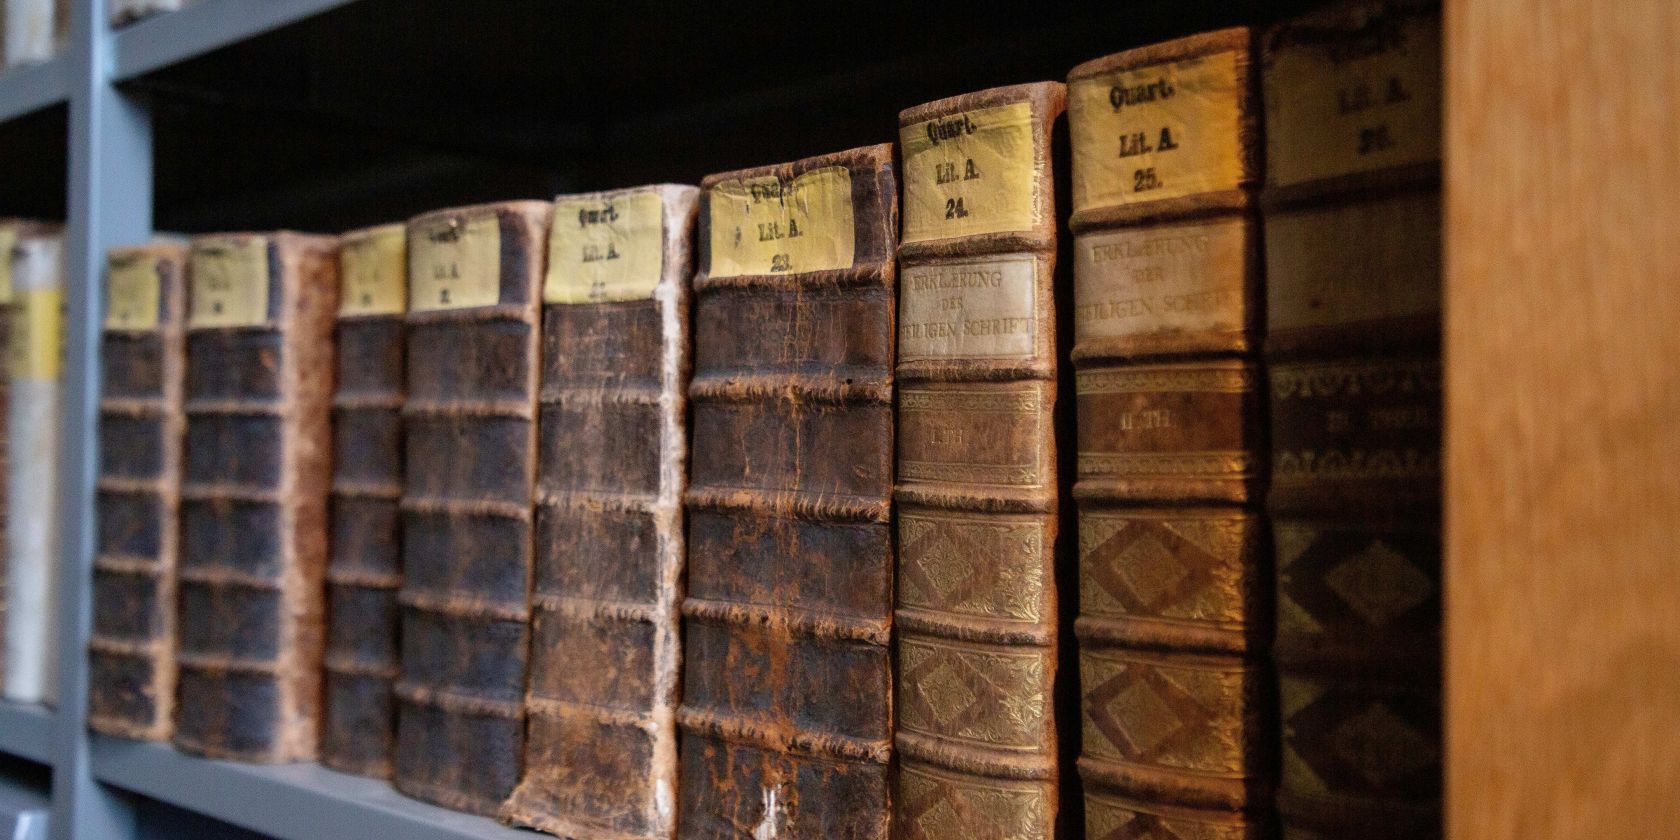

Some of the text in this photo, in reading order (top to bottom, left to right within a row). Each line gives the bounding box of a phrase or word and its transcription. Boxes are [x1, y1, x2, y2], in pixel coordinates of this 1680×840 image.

[1109, 78, 1176, 113] Quart.
[1119, 132, 1153, 158] Lit.
[1134, 168, 1163, 192] 25.
[758, 222, 785, 242] Lit.
